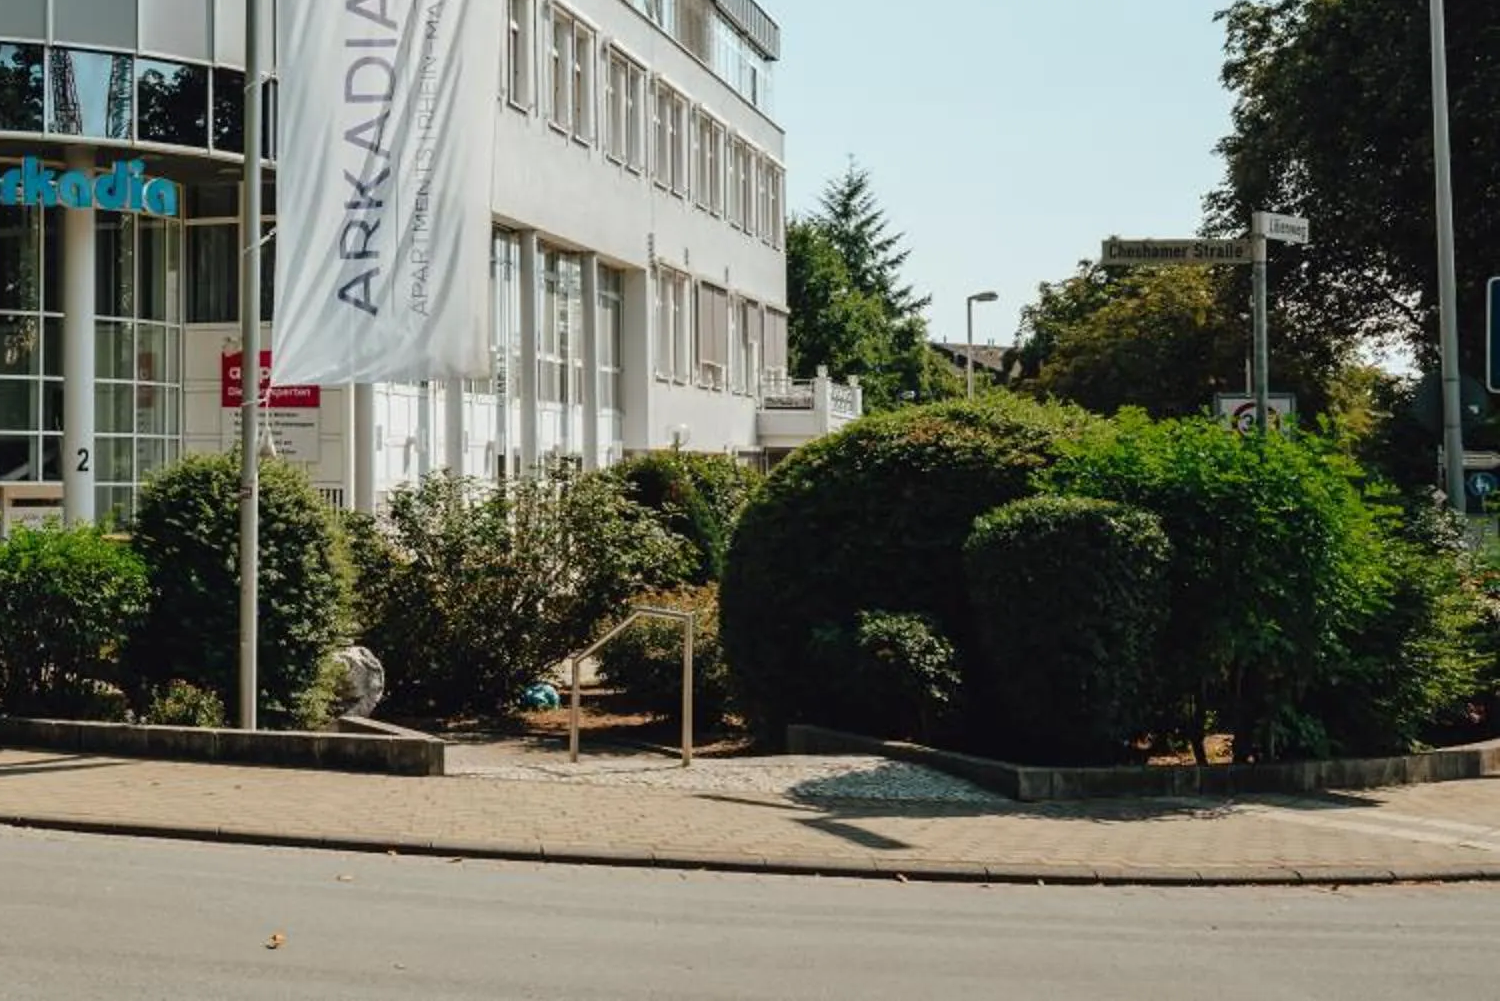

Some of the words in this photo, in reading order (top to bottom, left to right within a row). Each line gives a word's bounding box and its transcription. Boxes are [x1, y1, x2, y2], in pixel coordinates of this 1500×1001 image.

[411, 148, 432, 317] APARTMENTS
[1194, 242, 1243, 259] Straße
[76, 447, 90, 472] 2
